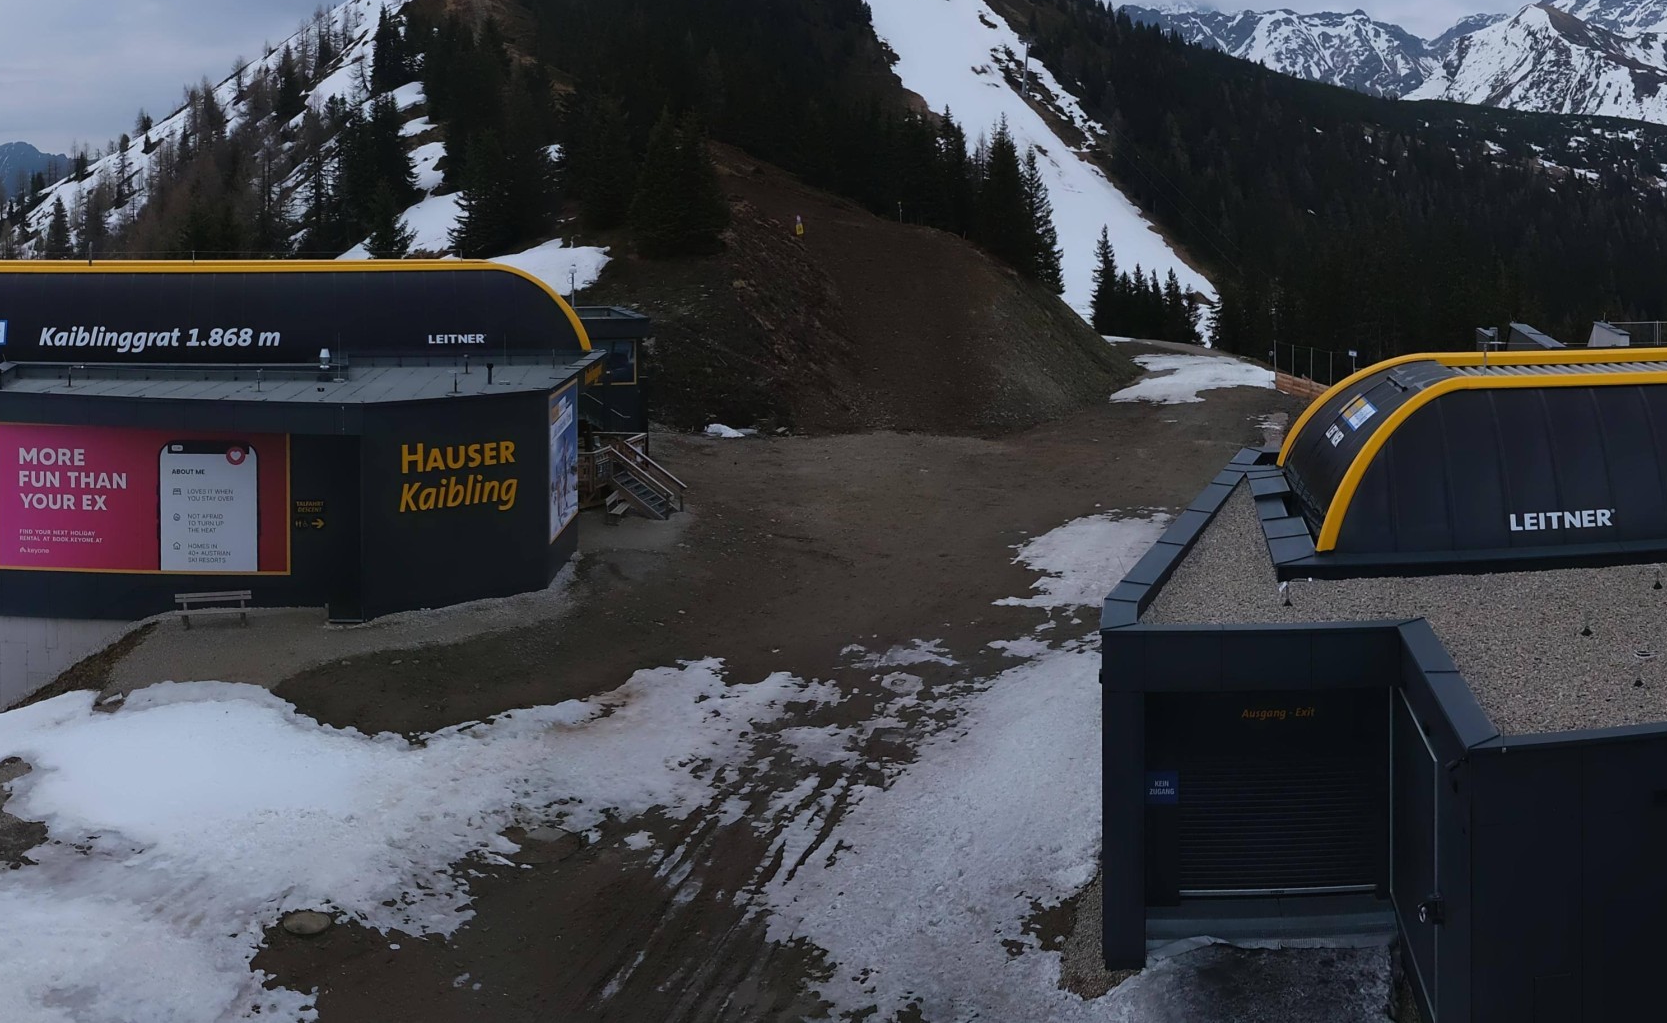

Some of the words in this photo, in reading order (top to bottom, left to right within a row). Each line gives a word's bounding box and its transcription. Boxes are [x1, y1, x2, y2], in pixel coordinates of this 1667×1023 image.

[39, 326, 181, 353] Kaiblinggrat
[186, 327, 253, 347] 1.868
[258, 331, 281, 347] m
[428, 333, 486, 344] LEITNER
[18, 447, 85, 466] MORE
[401, 440, 516, 474] HAUSER
[18, 470, 60, 488] FUN
[67, 471, 127, 489] THAN
[20, 492, 76, 510] YOUR
[82, 494, 108, 511] EX
[400, 474, 518, 513] Kaibling
[1509, 508, 1613, 531] LEITNER
[27, 547, 50, 555] keyone
[1241, 708, 1287, 721] Ausgang
[1295, 707, 1315, 717] Exit
